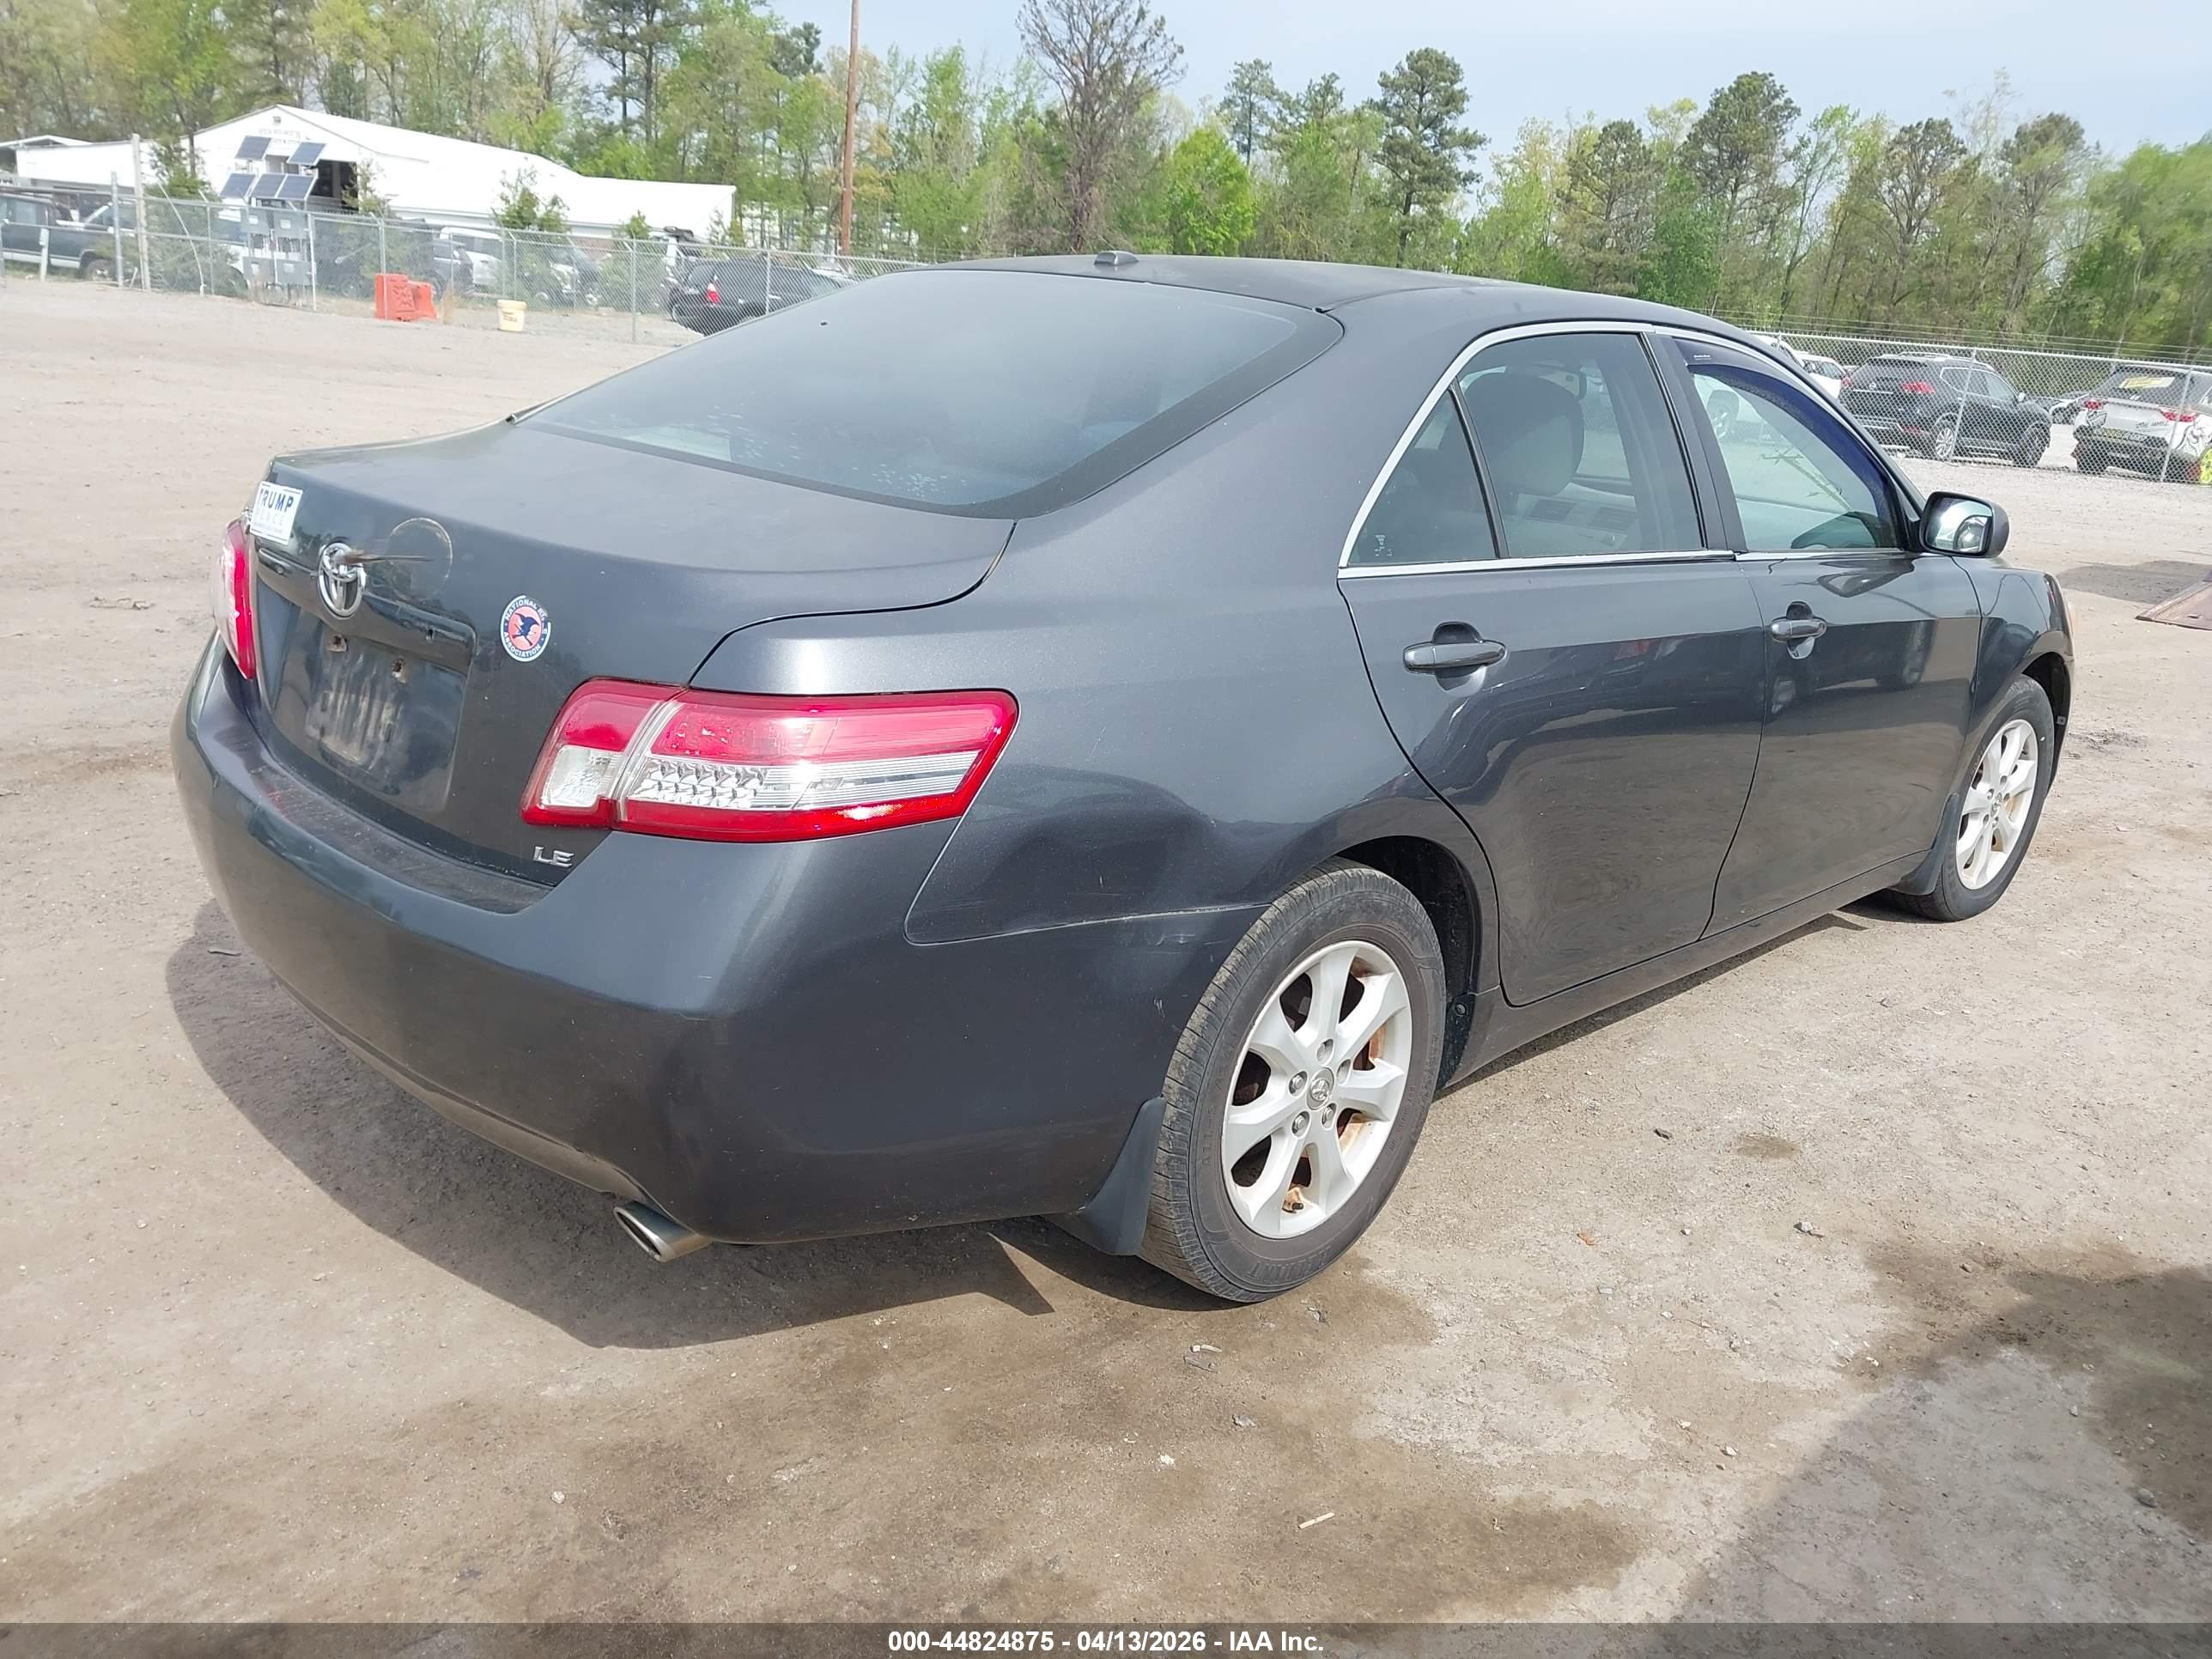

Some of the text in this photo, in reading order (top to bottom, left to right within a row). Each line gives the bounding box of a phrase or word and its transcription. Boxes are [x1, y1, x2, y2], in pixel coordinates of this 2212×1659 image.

[258, 488, 295, 513] TRUMP
[505, 599, 538, 620] NATIONAL
[503, 631, 541, 658] ASSOCIATION
[533, 846, 574, 867] LE
